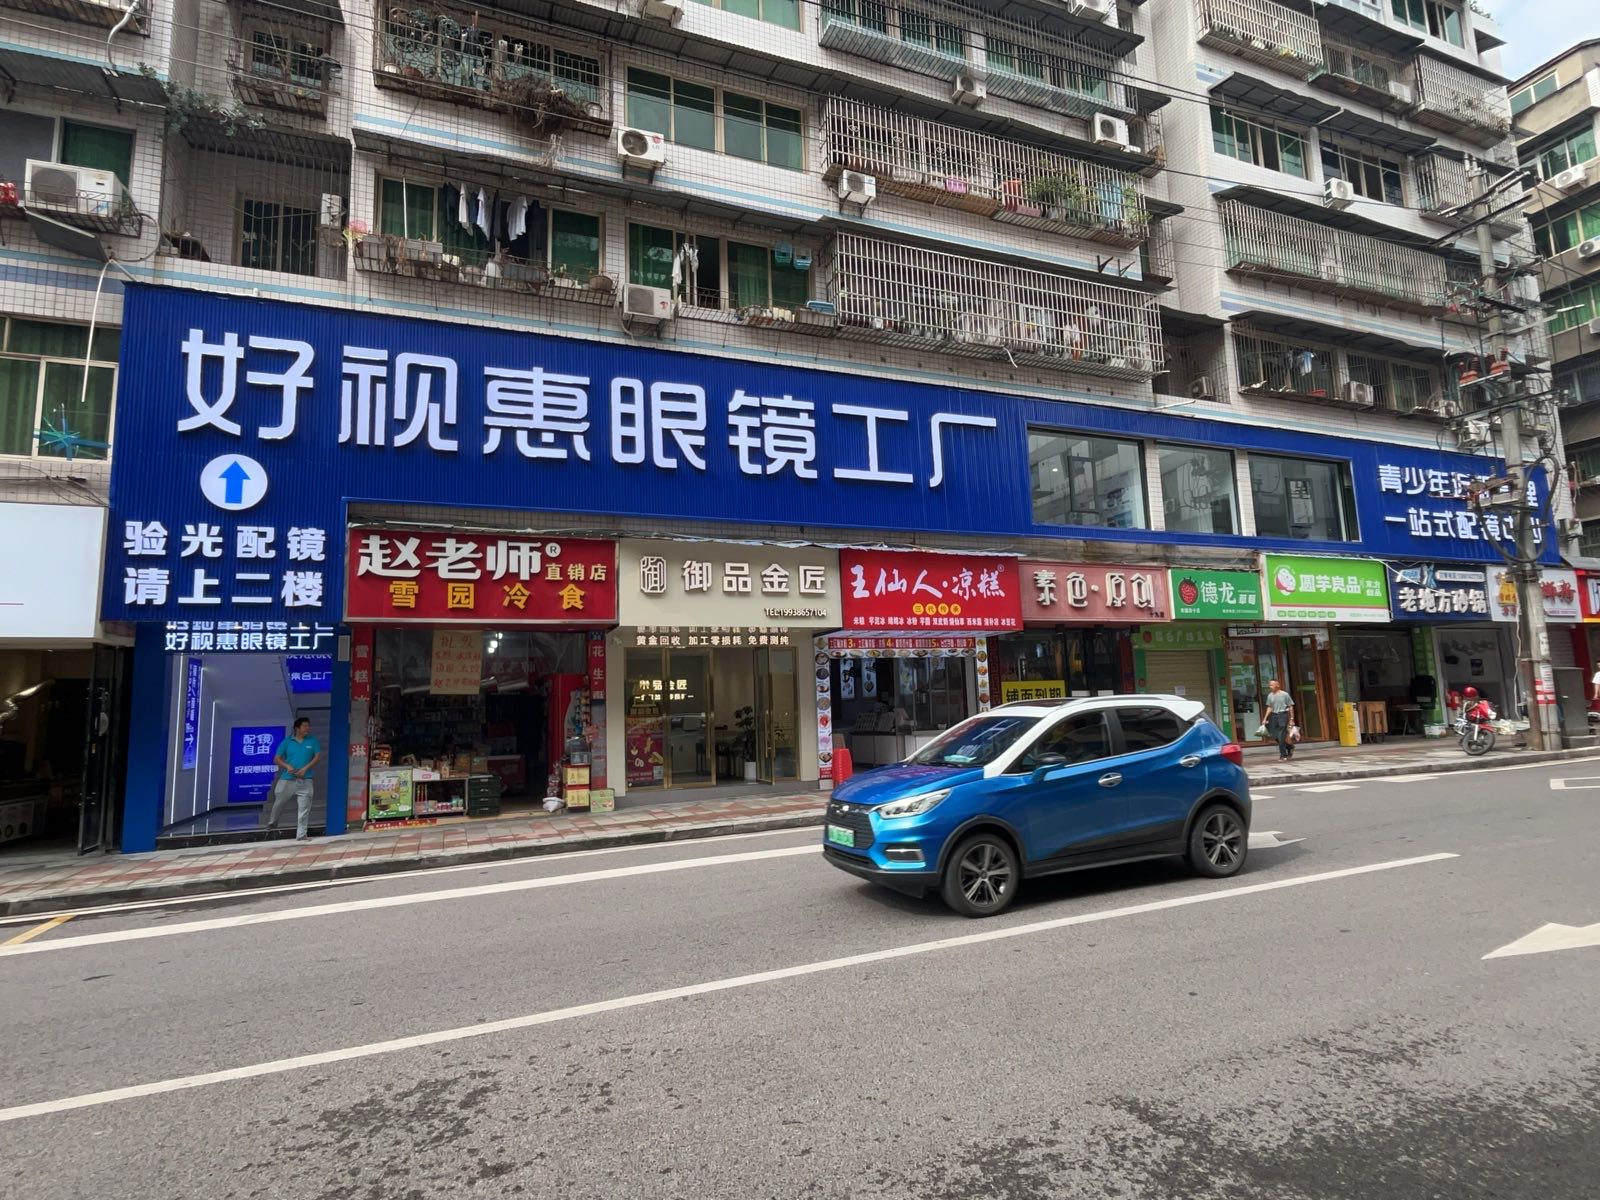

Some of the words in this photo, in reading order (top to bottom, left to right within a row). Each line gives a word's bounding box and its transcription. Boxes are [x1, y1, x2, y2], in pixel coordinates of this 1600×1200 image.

[177, 328, 997, 488] 好视惠眼镜工厂
[123, 521, 326, 561] 验光配镜
[357, 535, 542, 580] 赵老师
[545, 563, 606, 581] 直销店
[682, 560, 826, 593] 御品金匠
[123, 567, 323, 607] 请上二楼
[389, 580, 586, 610] 雪园冷食
[1200, 581, 1237, 604] 德龙
[1399, 586, 1488, 613] 老地方砂锅
[165, 632, 334, 650] 好视惠眼镜工厂
[636, 635, 681, 646] 黄金回收
[688, 635, 742, 646] 加工零损耗
[748, 635, 790, 646] 免费测纯
[288, 671, 332, 681] 集合工厂
[1006, 687, 1062, 702] 铺面到期
